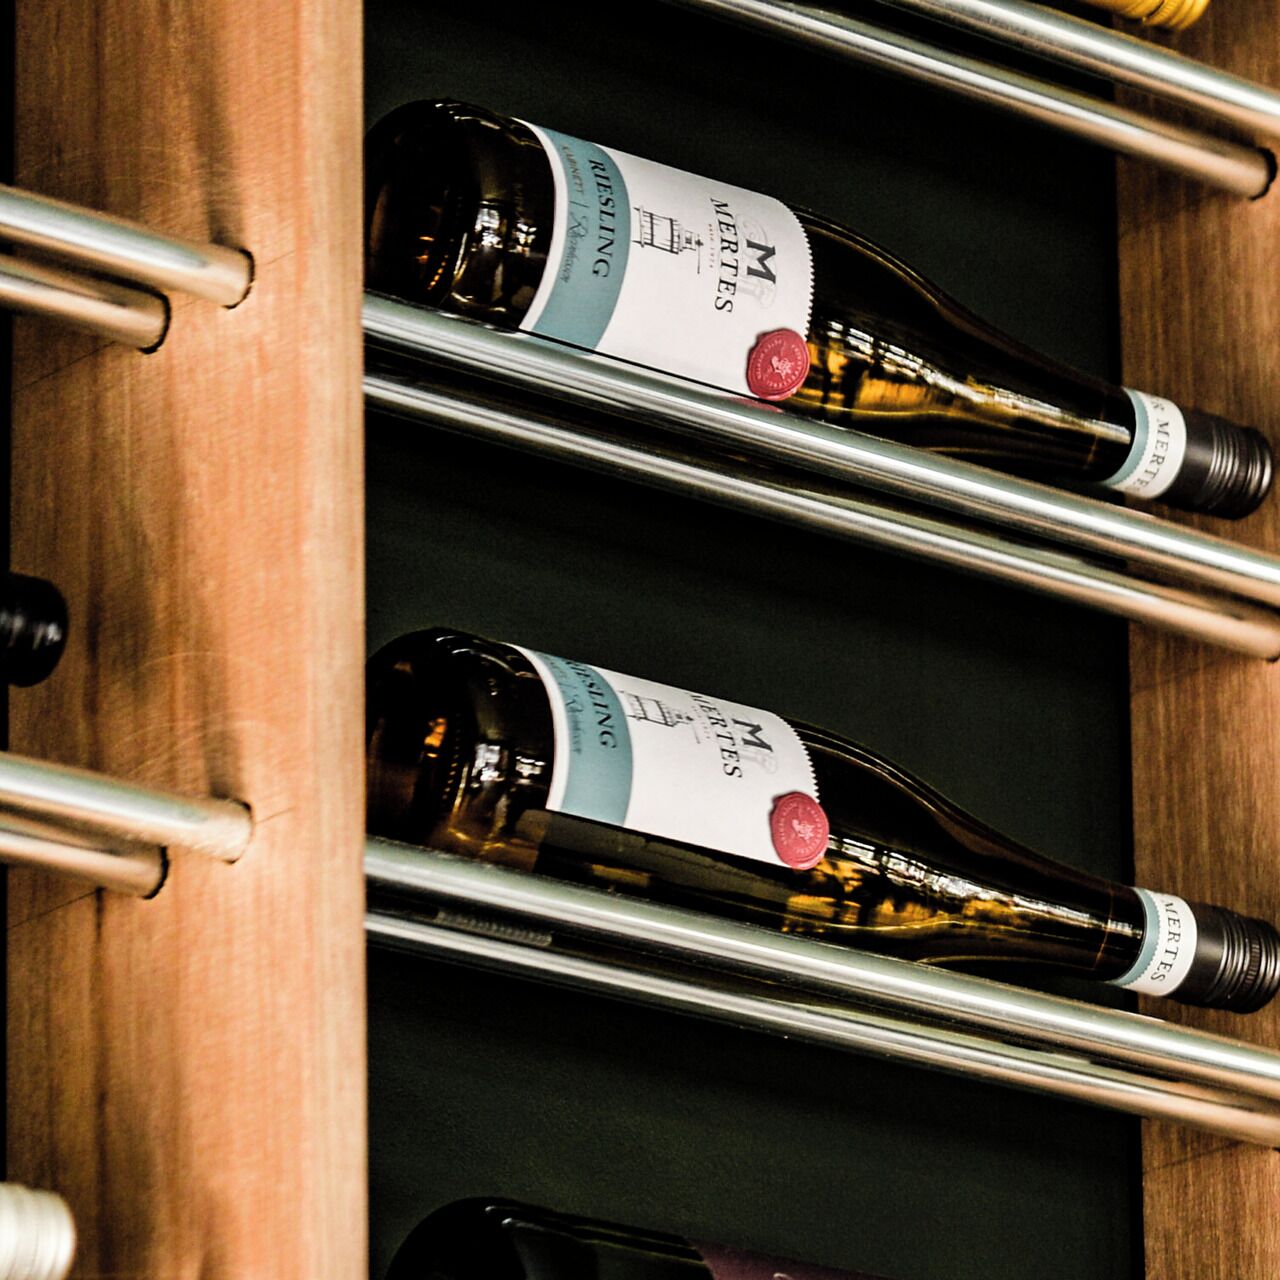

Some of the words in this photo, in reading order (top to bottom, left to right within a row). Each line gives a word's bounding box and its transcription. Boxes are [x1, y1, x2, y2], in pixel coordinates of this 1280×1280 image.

[588, 157, 617, 280] RIESLING
[710, 197, 740, 313] MERTES
[1150, 900, 1182, 983] MERTES
